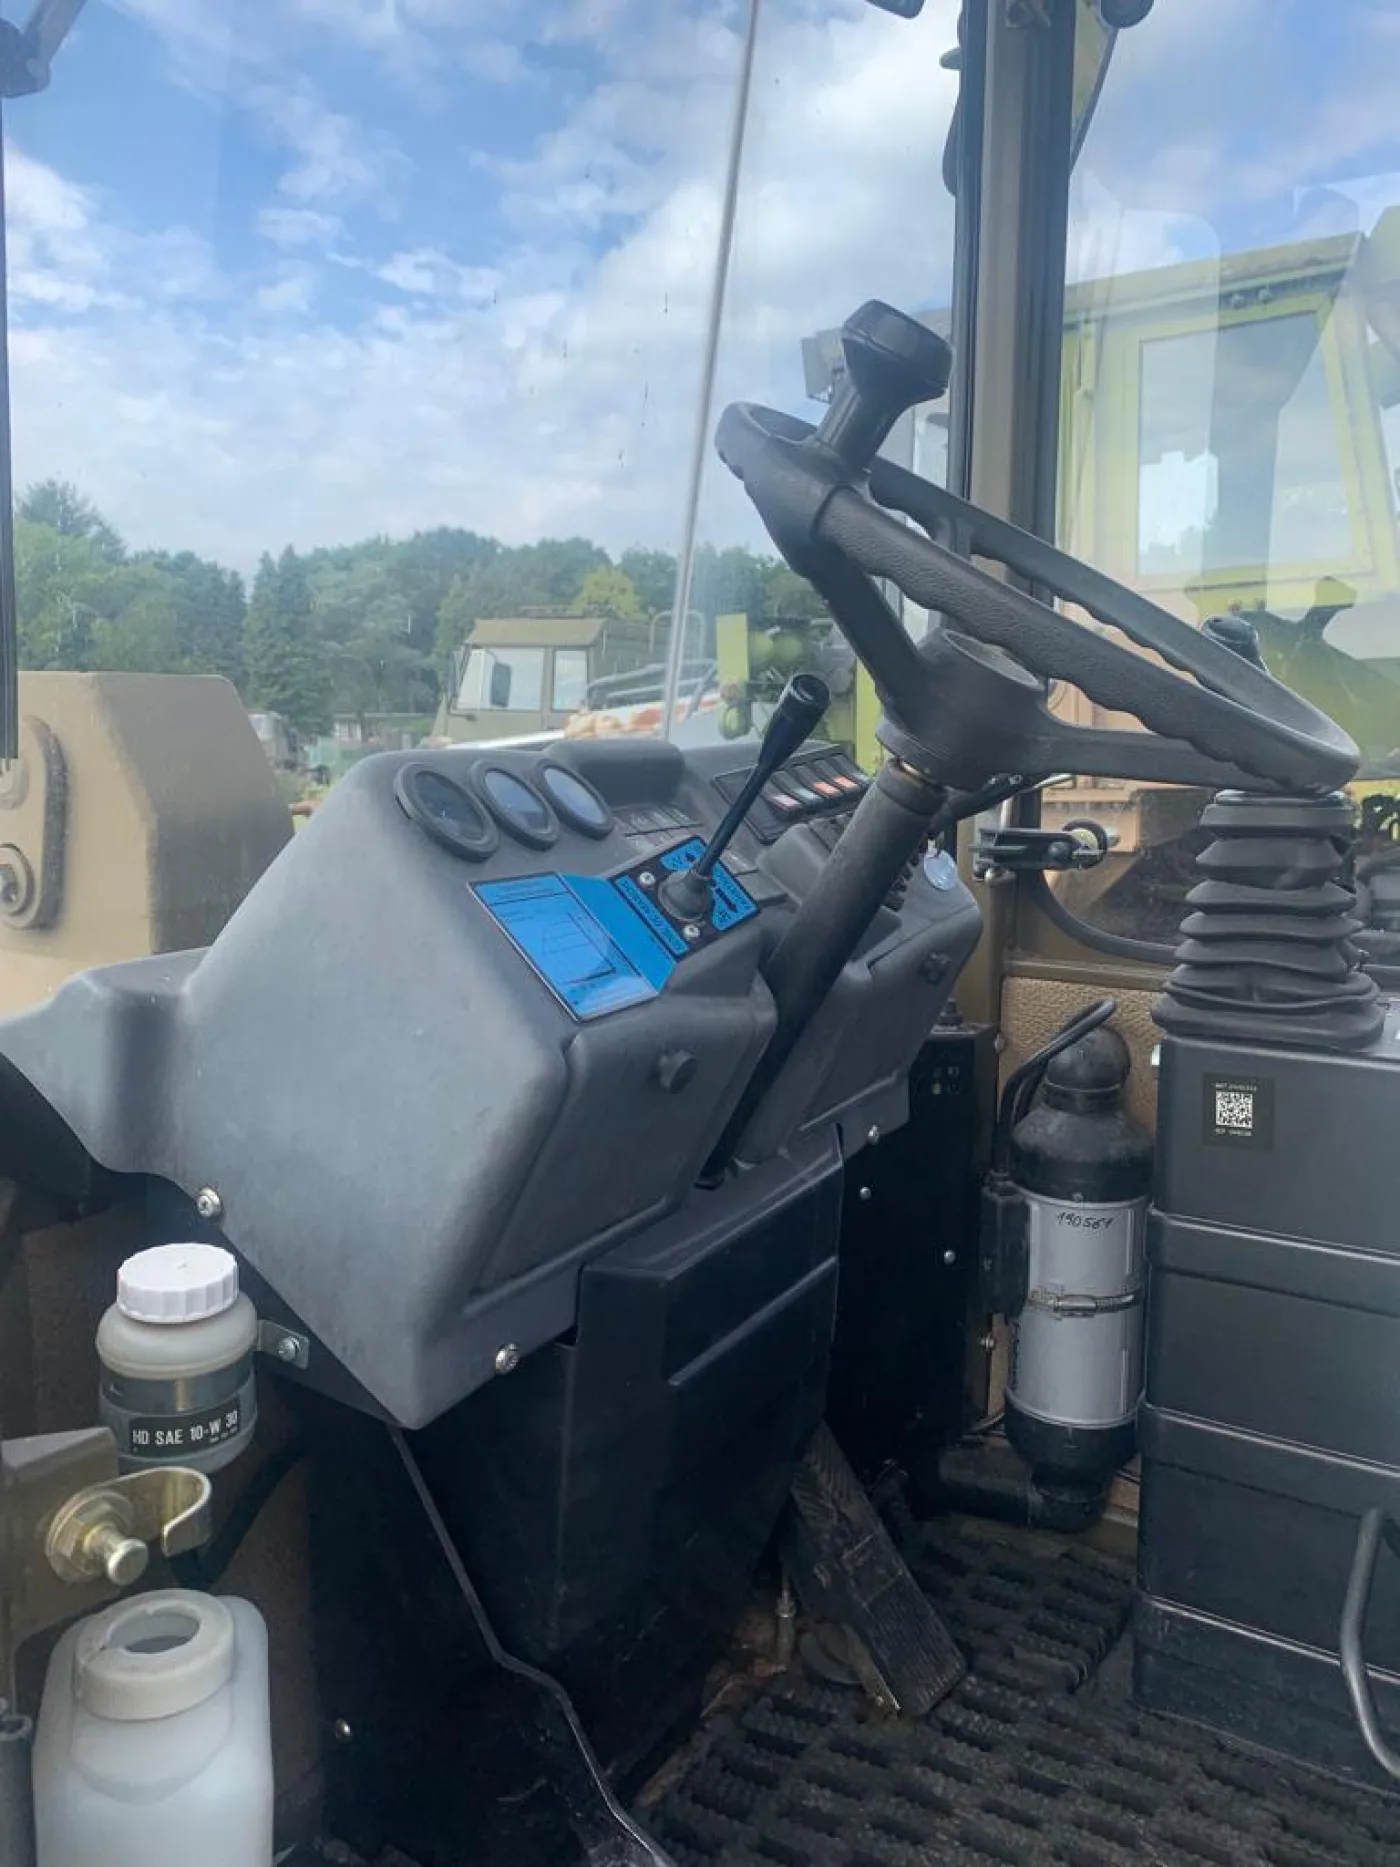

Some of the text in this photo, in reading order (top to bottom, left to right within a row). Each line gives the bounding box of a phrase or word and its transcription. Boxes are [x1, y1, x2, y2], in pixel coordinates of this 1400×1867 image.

[132, 1429, 149, 1445] HD
[155, 1429, 184, 1445] SAE
[190, 1419, 221, 1440] 10-W
[226, 1410, 238, 1427] 30
